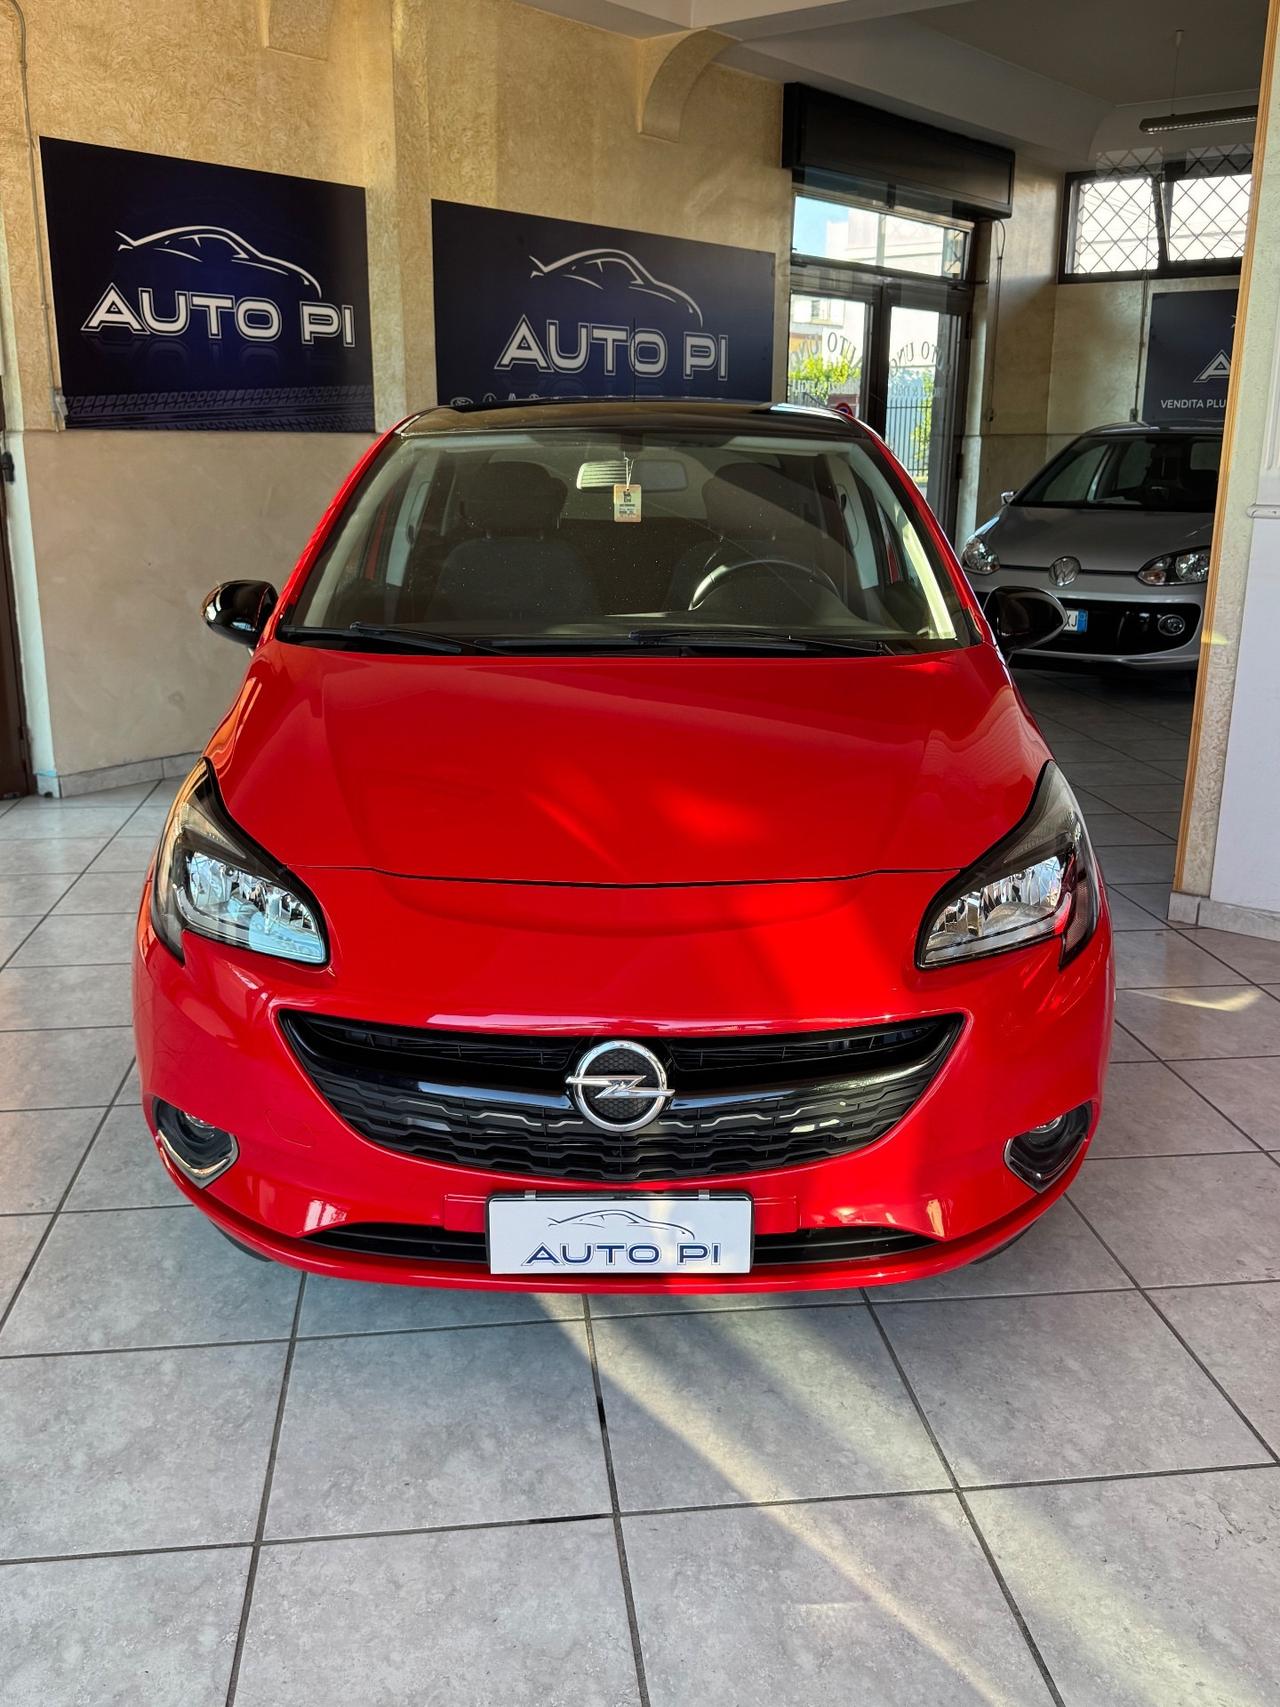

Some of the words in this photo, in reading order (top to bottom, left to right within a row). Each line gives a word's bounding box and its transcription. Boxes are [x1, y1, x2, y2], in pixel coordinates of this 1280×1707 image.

[81, 282, 282, 342] AUTO
[300, 301, 355, 347] PI
[494, 314, 667, 377] AUTO
[683, 331, 728, 381] PI
[1160, 399, 1204, 409] VENDITA
[521, 1242, 664, 1266] AUTO
[677, 1242, 720, 1266] PI
